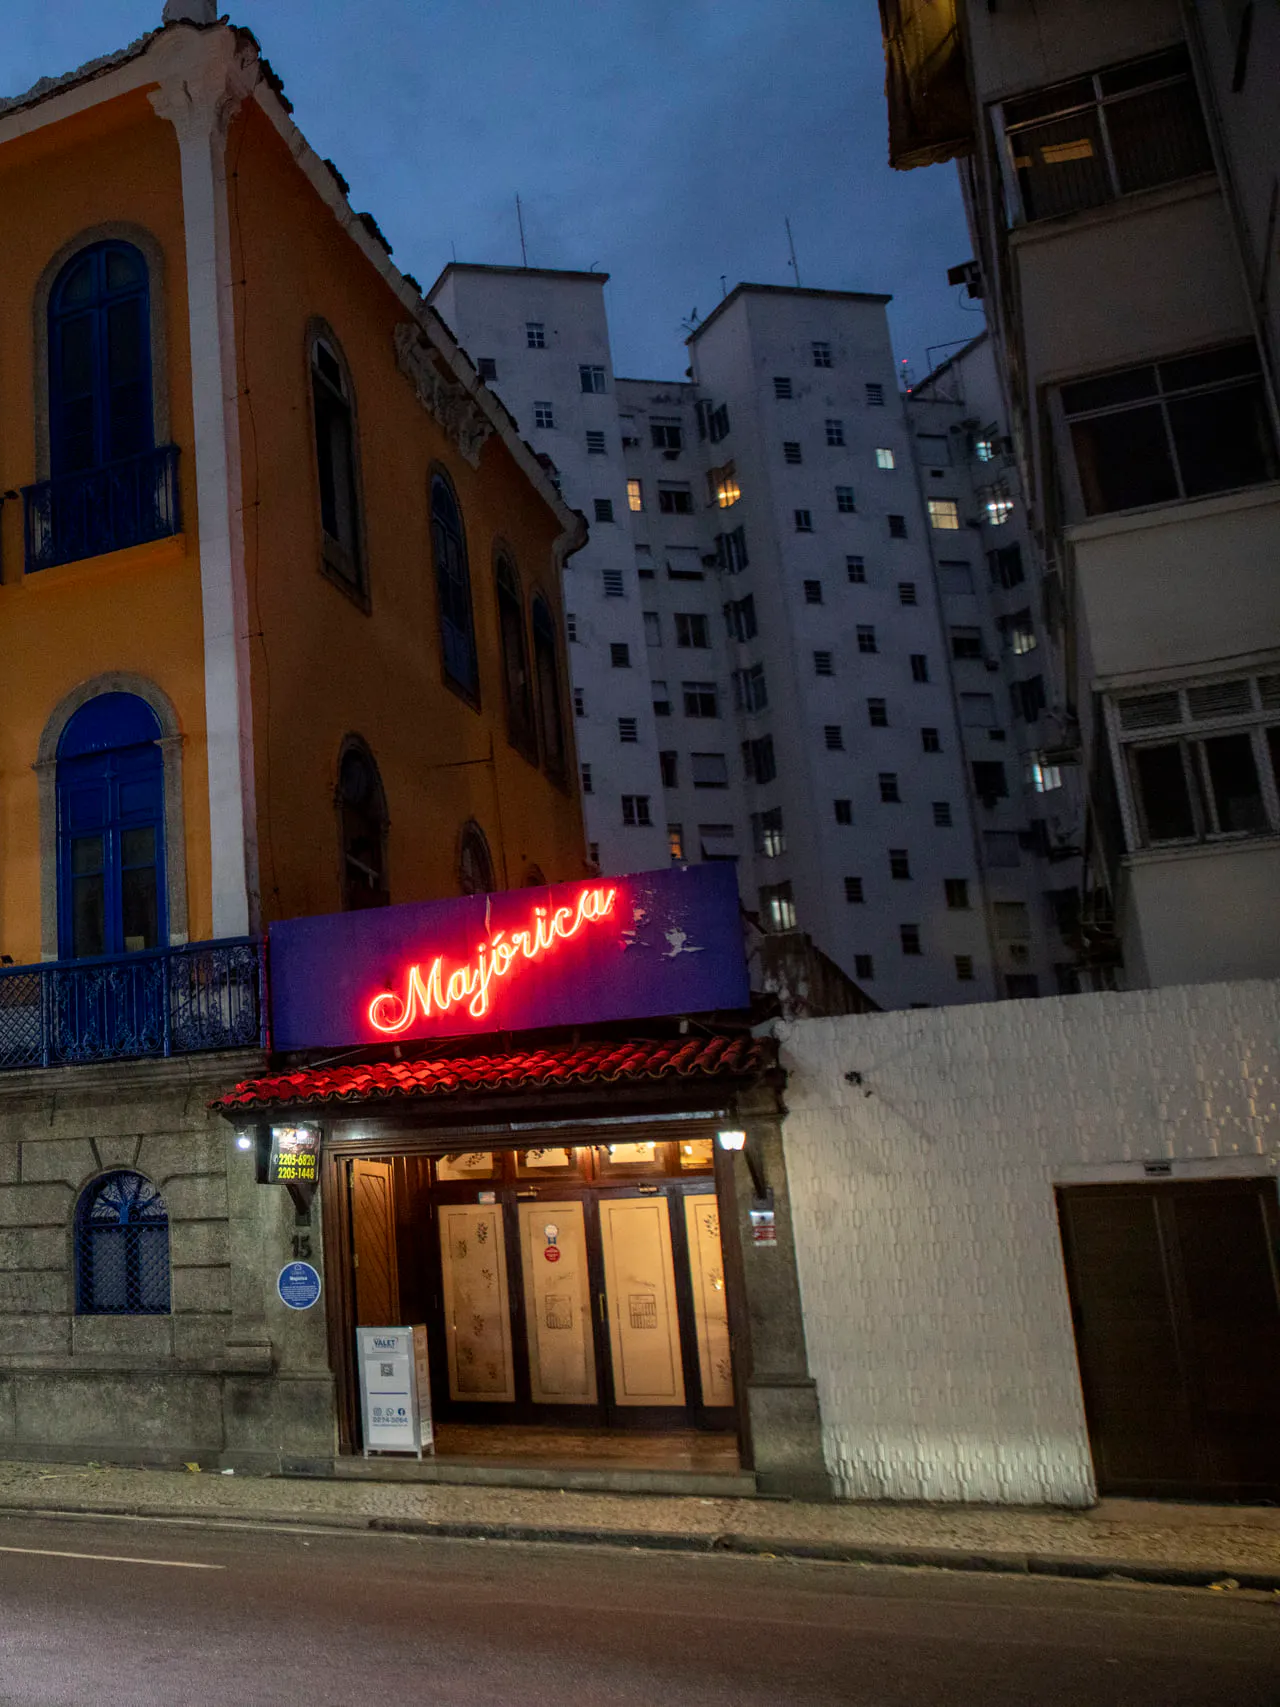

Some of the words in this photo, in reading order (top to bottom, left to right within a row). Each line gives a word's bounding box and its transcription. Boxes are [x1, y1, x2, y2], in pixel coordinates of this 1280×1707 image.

[369, 887, 618, 1034] Majórica
[279, 1153, 316, 1167] 2205-6820
[278, 1166, 315, 1180] 2205-1448
[291, 1235, 312, 1258] 15
